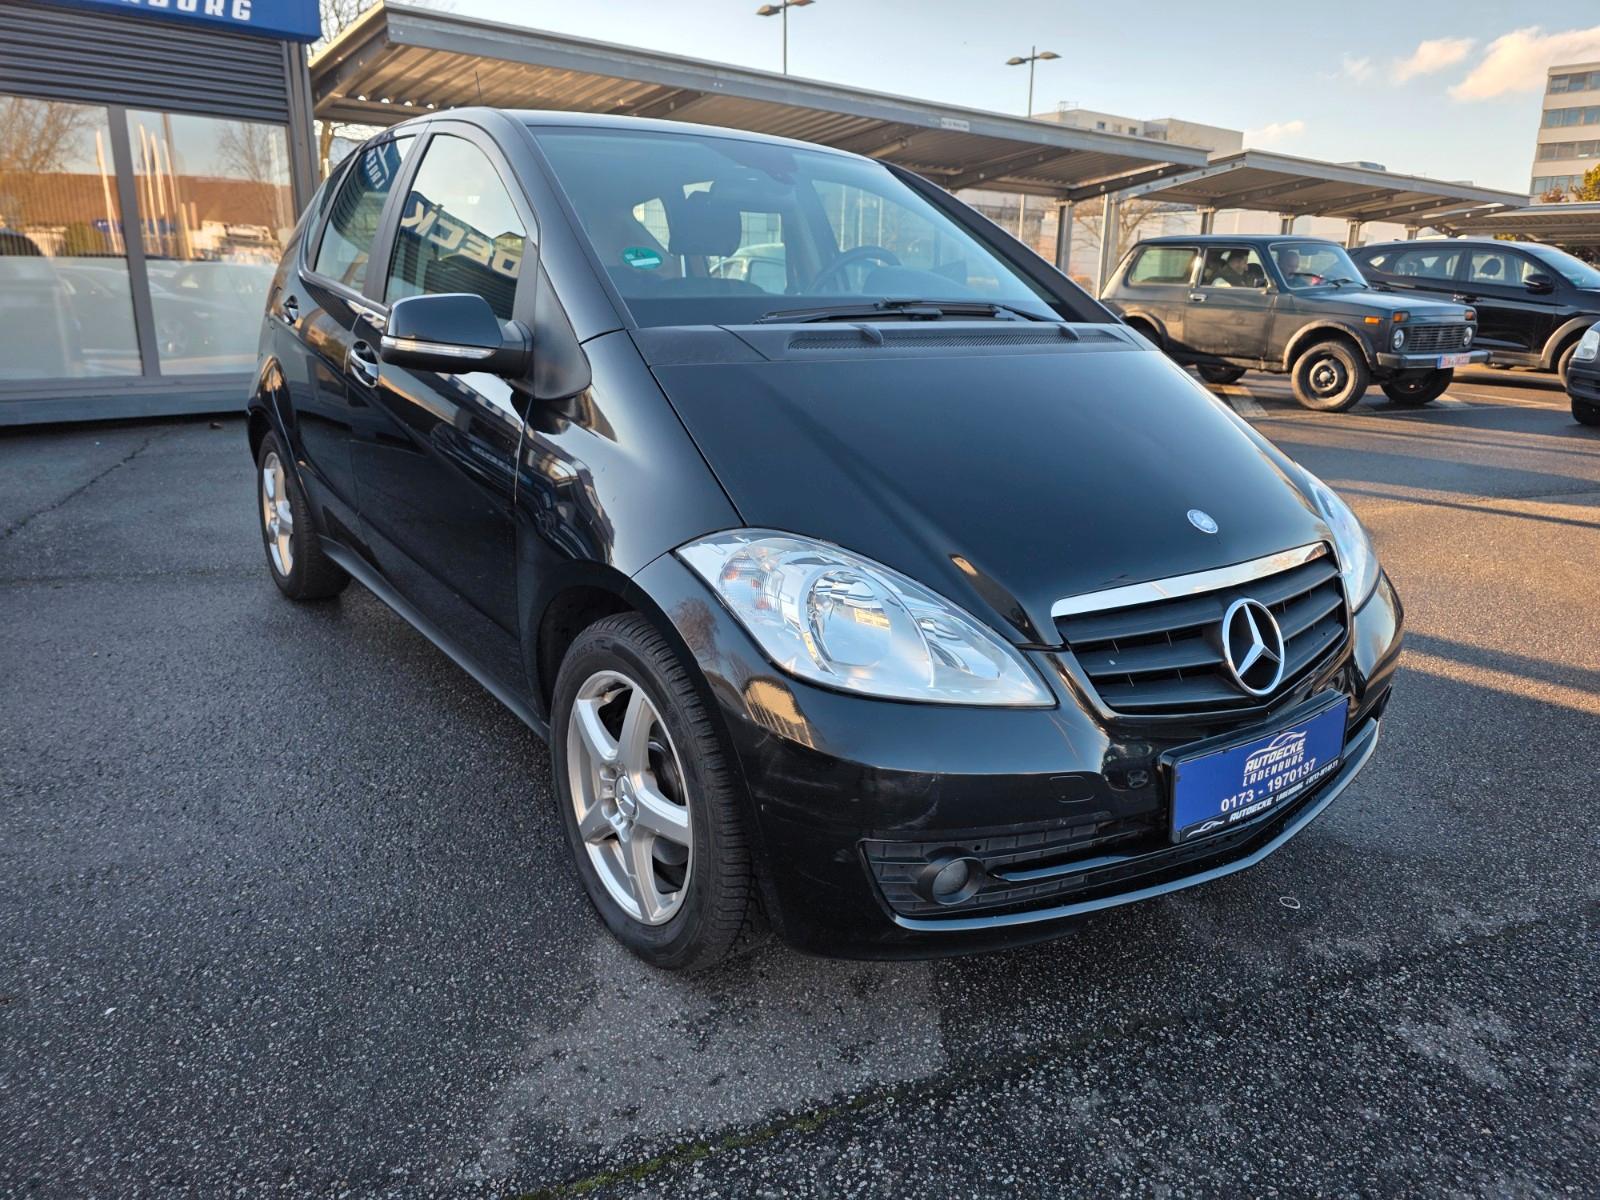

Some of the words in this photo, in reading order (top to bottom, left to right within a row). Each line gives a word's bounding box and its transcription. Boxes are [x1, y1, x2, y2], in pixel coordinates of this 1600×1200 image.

[1242, 752, 1305, 787] LADENBURG
[1244, 738, 1306, 773] AUTOECKE
[1221, 789, 1255, 812] 0173
[1268, 757, 1316, 793] 1970137
